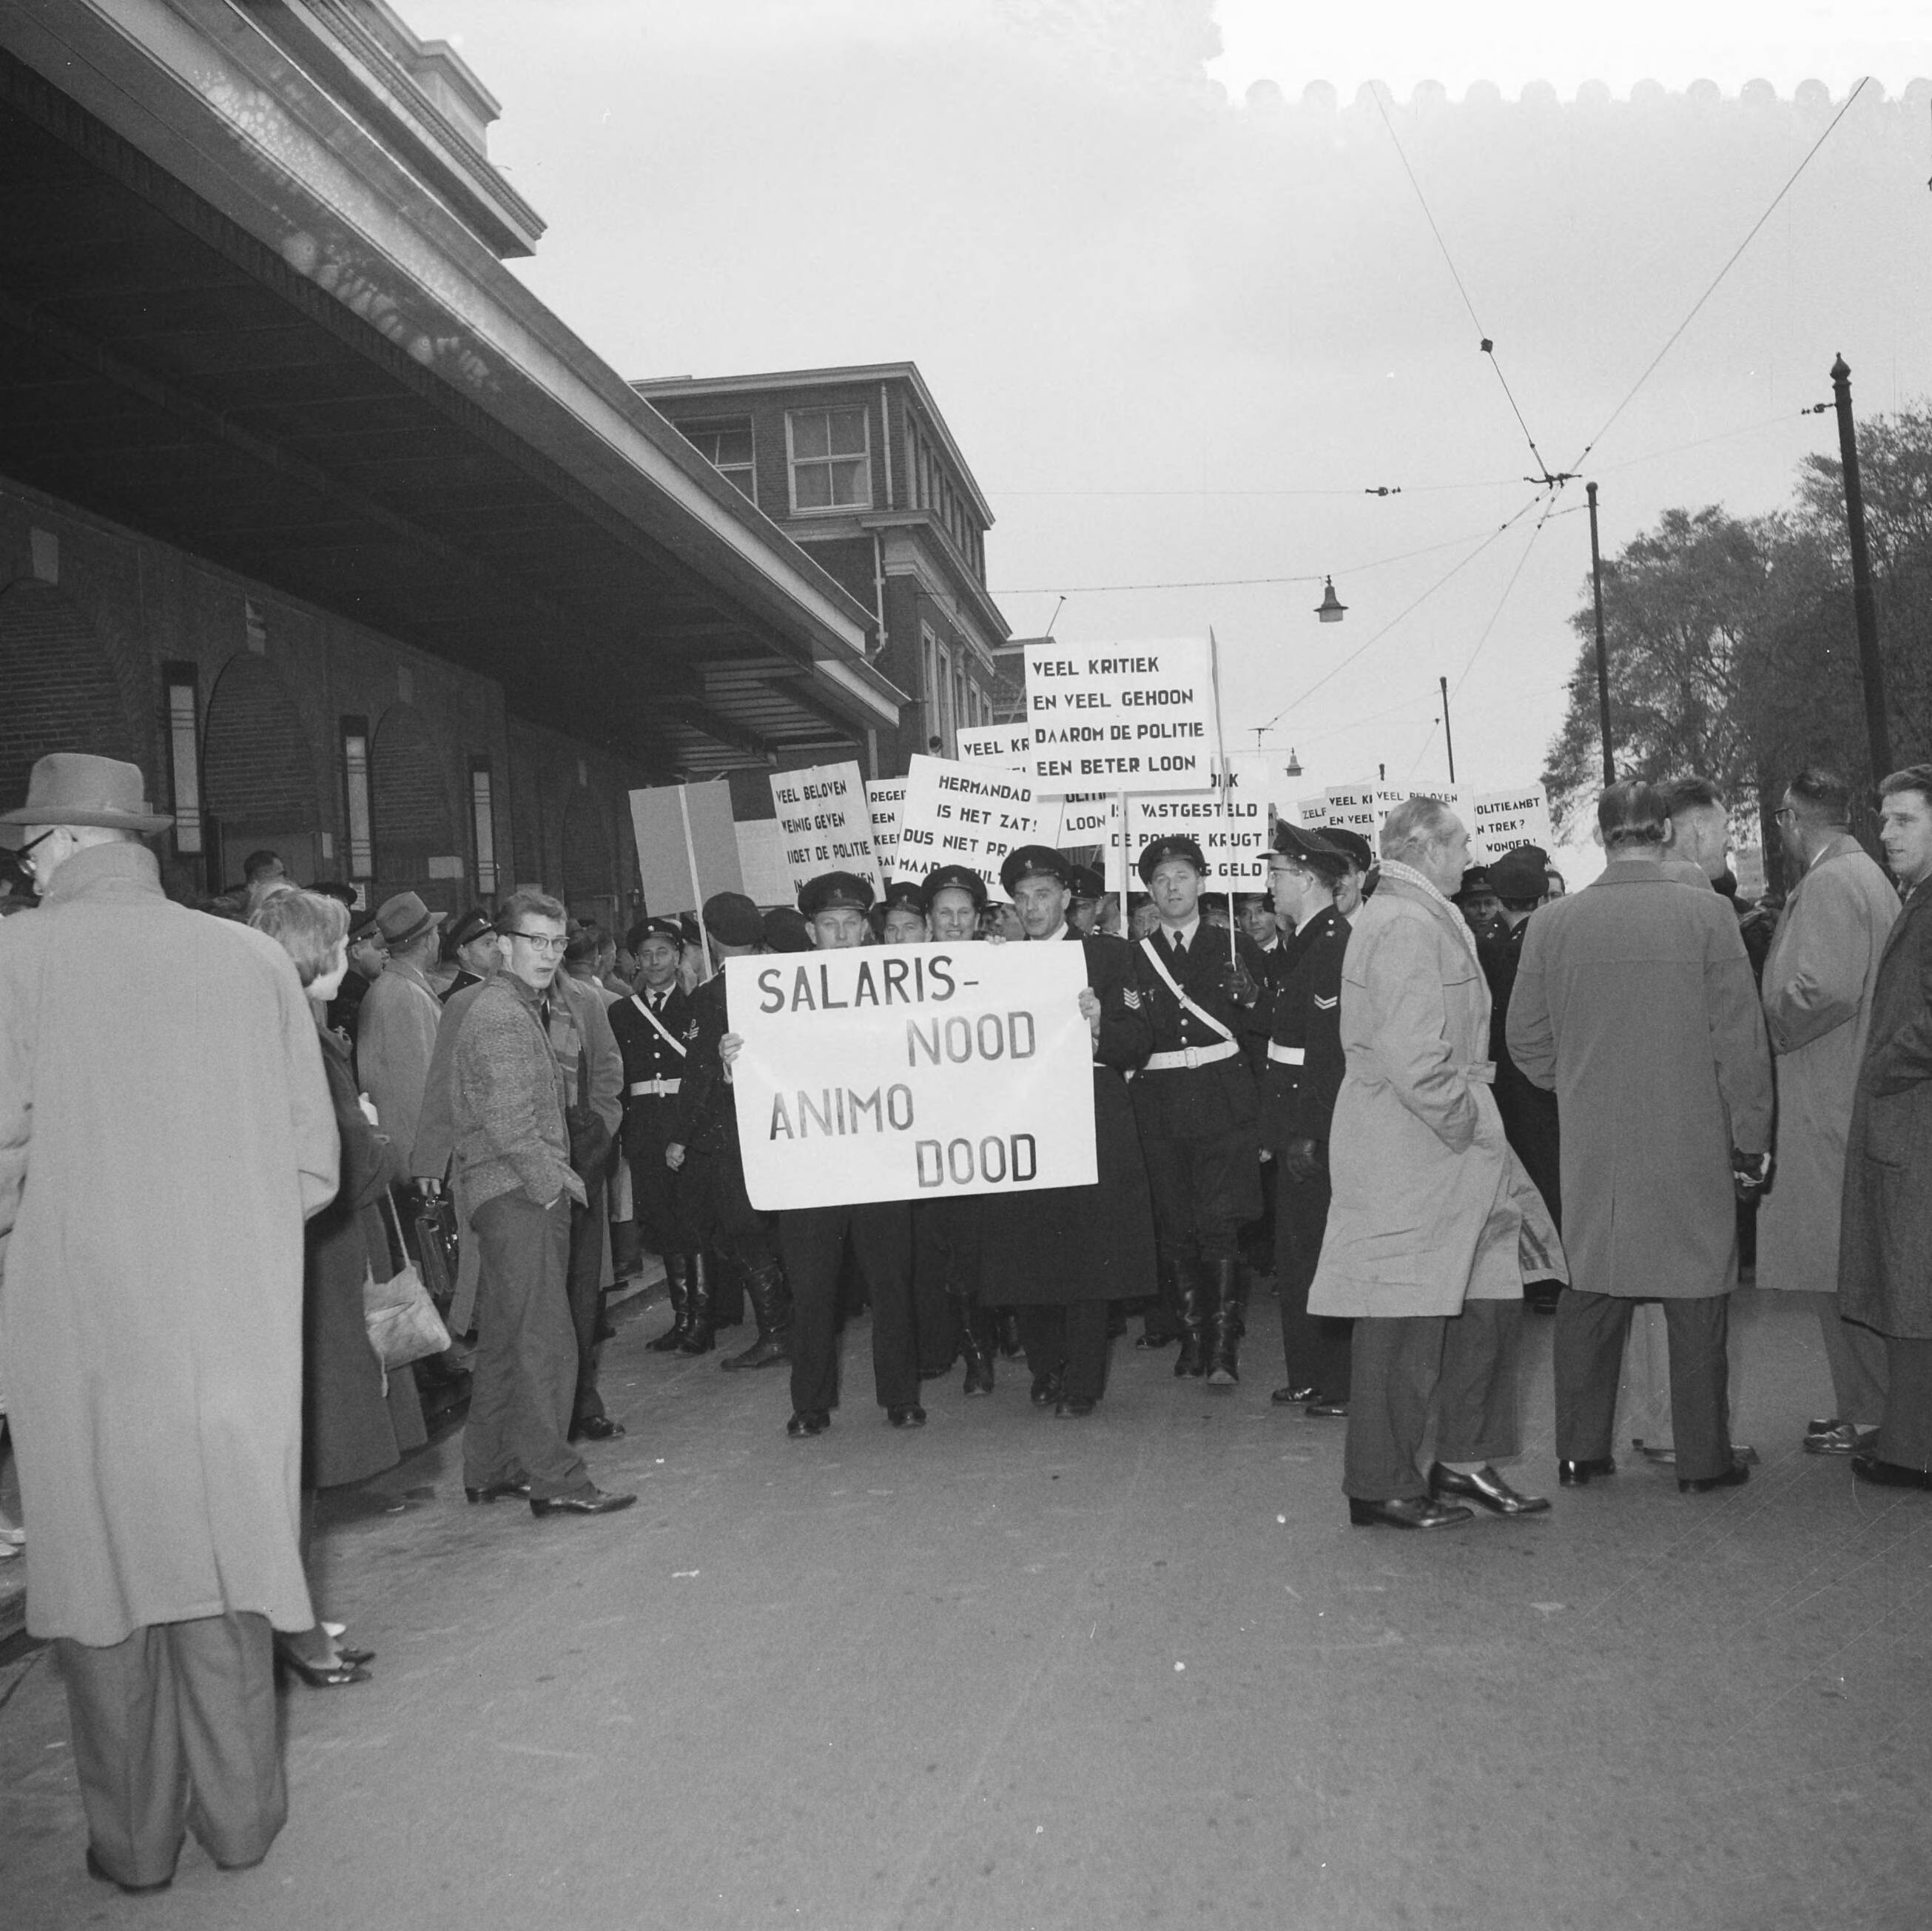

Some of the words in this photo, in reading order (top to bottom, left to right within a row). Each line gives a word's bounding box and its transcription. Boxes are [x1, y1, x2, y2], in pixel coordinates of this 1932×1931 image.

[1032, 660, 1080, 676] VEEL
[1088, 656, 1159, 675] KRITIEK
[1034, 695, 1057, 711] EN
[1064, 693, 1111, 709] VEEL
[1122, 689, 1194, 707] GEHOON
[1035, 727, 1104, 744] DAAROM
[1111, 725, 1132, 741] DE
[1137, 722, 1205, 739] POLITIE
[964, 741, 1004, 756] VEEL
[1037, 760, 1072, 776] EEN
[1080, 757, 1140, 775] BETER
[1148, 755, 1196, 772] LOON
[776, 788, 801, 804] VEEL
[803, 779, 847, 801] BELOVEN
[938, 775, 1031, 802] HERMANDAD
[1376, 791, 1404, 802] VEEL
[1142, 804, 1257, 818] VASTGESTELD
[1329, 796, 1357, 807] VEEL
[1475, 797, 1541, 815] OLITIEAMBT
[815, 811, 846, 830] GEVEN
[872, 812, 895, 824] EEN
[937, 804, 952, 819] IS
[960, 807, 992, 825] HET
[1066, 815, 1105, 831] LOON
[1330, 816, 1344, 826] EN
[1348, 813, 1375, 825] VEEL
[903, 828, 934, 844] DUS
[943, 834, 979, 852] NIET
[1111, 833, 1133, 847] DE
[815, 845, 829, 861] DE
[832, 840, 872, 859] POLITIE
[1218, 862, 1262, 877] GELD
[758, 956, 980, 1013] SALARIS-
[907, 1011, 1036, 1067] NOOD
[770, 1084, 914, 1141] ANIMO
[915, 1133, 1037, 1188] DOOD
